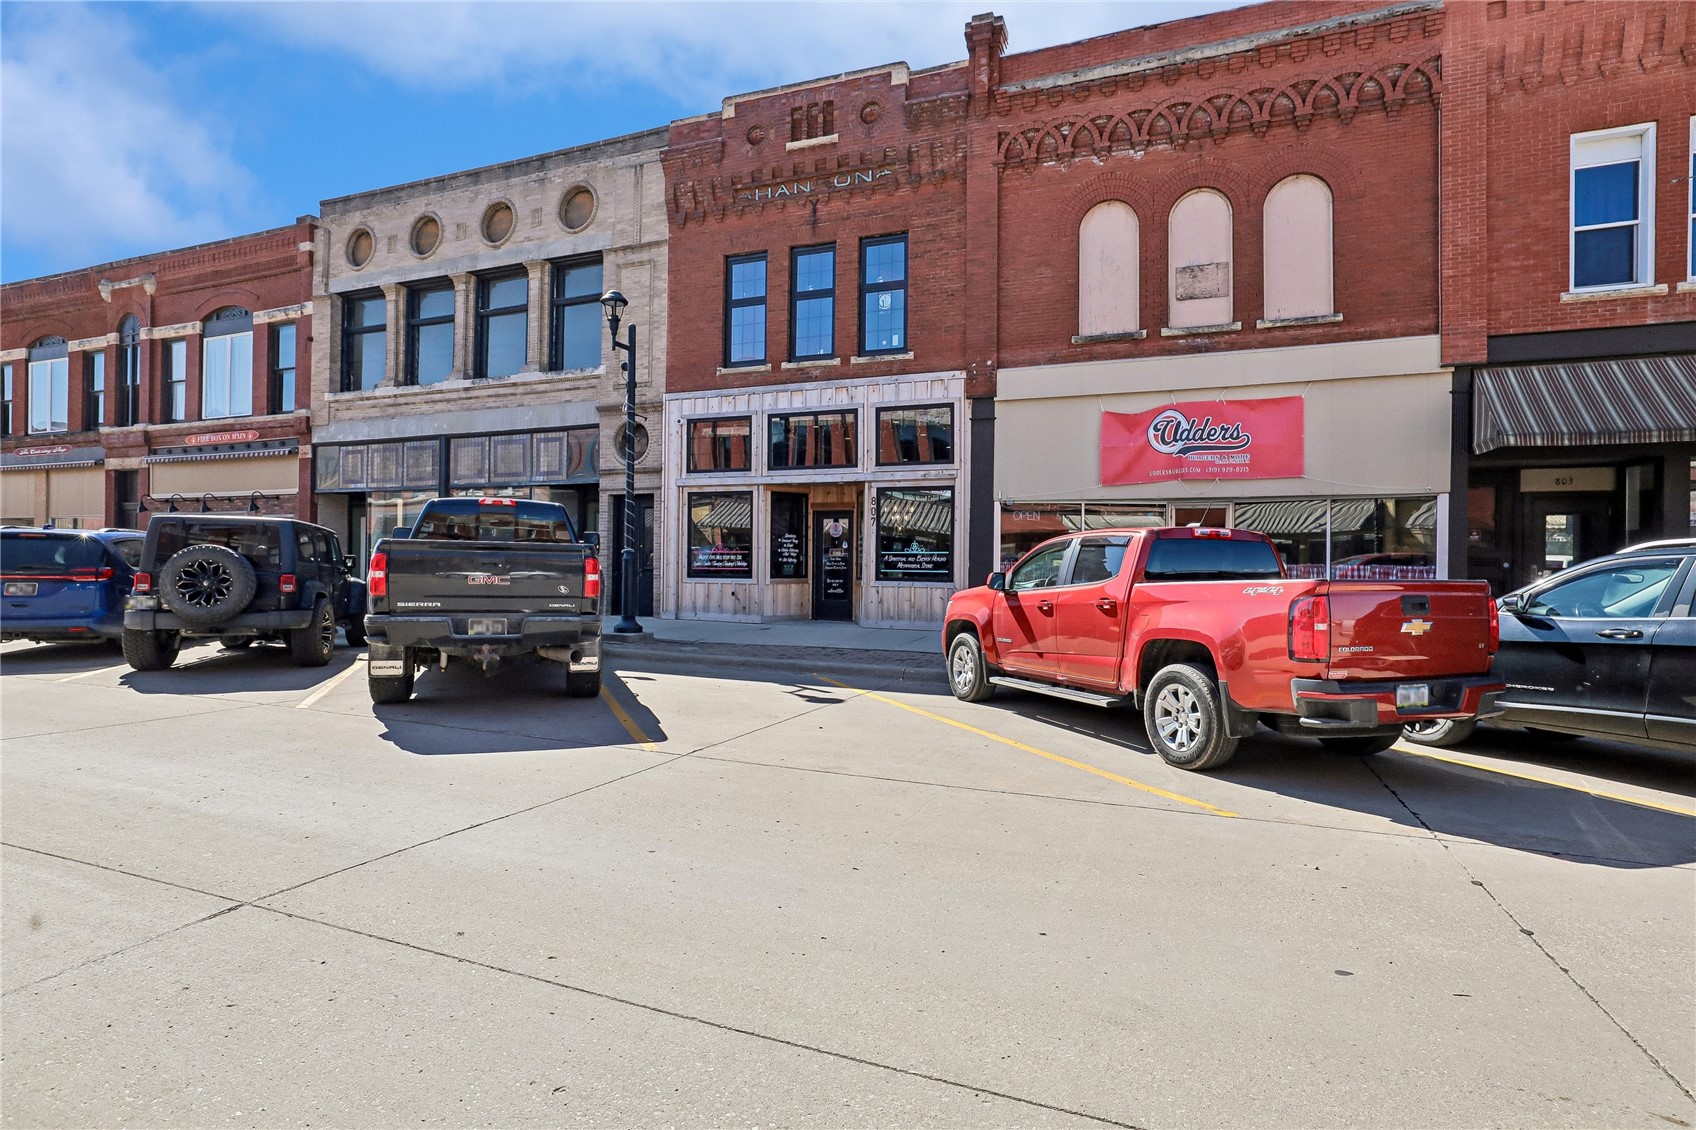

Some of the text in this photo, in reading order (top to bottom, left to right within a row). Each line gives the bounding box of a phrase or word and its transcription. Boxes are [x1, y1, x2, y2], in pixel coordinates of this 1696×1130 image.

[197, 435, 209, 443] FIRE
[231, 432, 247, 440] MAIN
[1152, 416, 1250, 450] Udders
[1229, 453, 1251, 461] MORE
[1555, 477, 1574, 486] 803
[1012, 510, 1041, 521] OPEN
[467, 575, 511, 585] GMC
